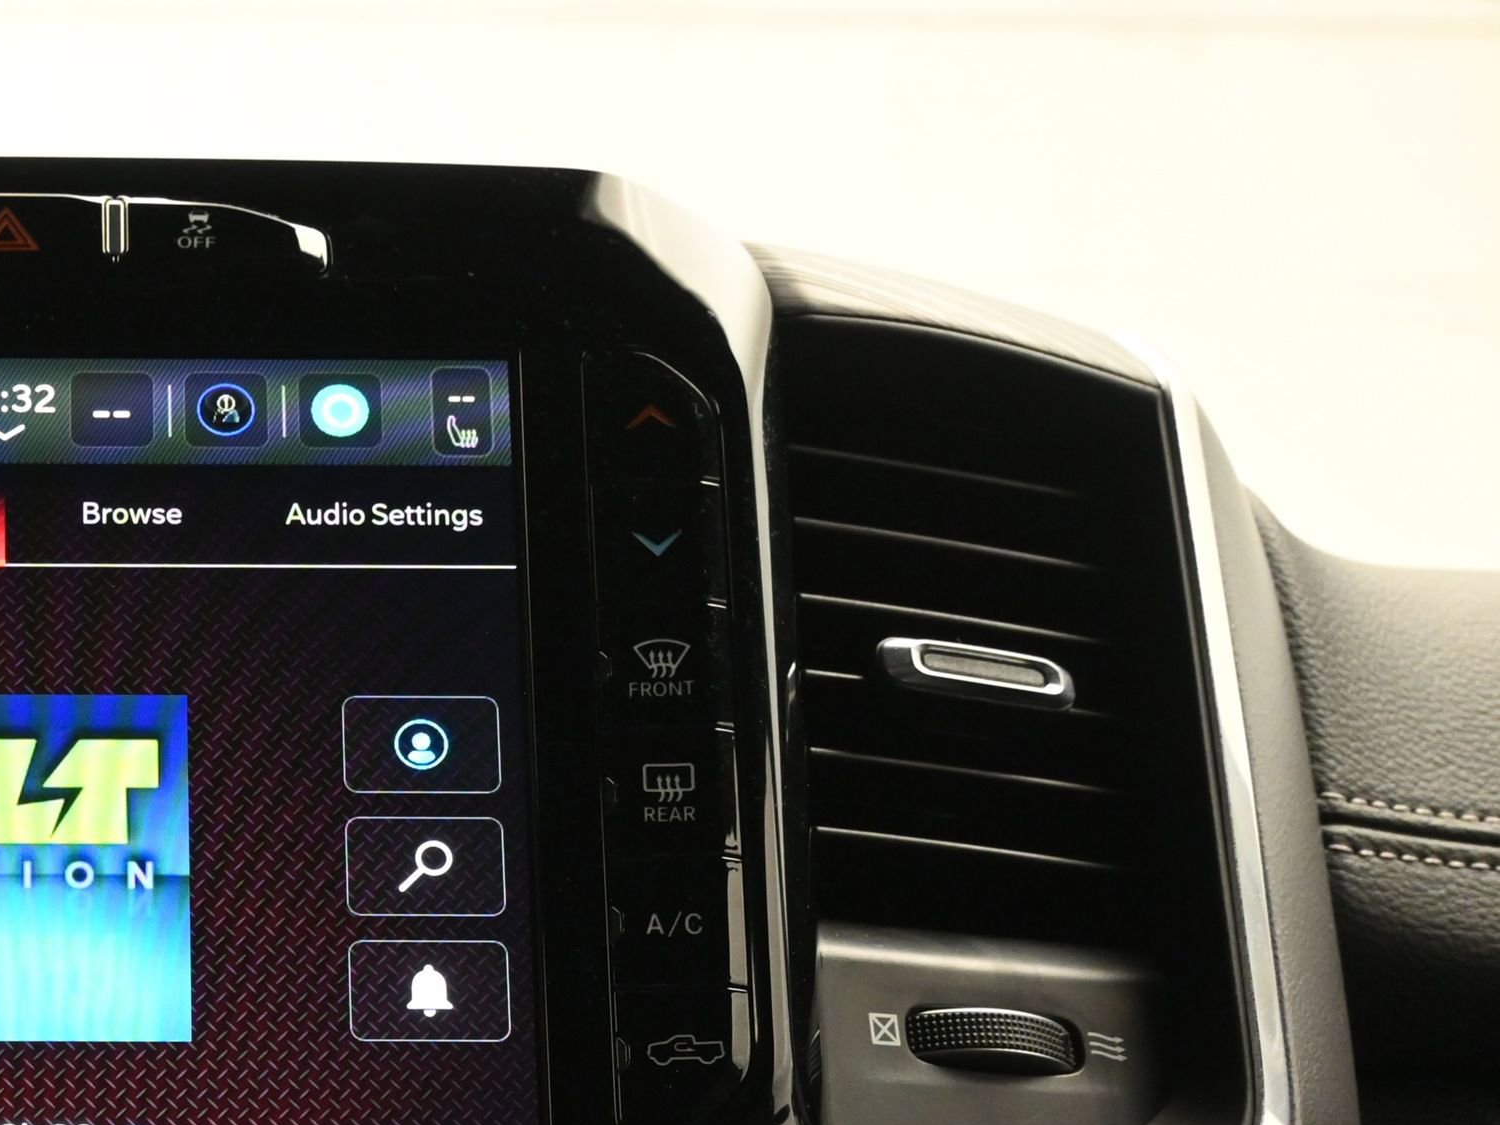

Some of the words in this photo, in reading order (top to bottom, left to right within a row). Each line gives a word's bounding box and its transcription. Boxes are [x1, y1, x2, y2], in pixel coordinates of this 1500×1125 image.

[176, 236, 215, 249] OFF
[82, 501, 183, 525] Browse
[285, 501, 366, 526] Audio
[371, 501, 484, 532] Settings
[628, 680, 694, 698] FRONT
[643, 806, 696, 823] REAR
[646, 911, 703, 938] A/C
